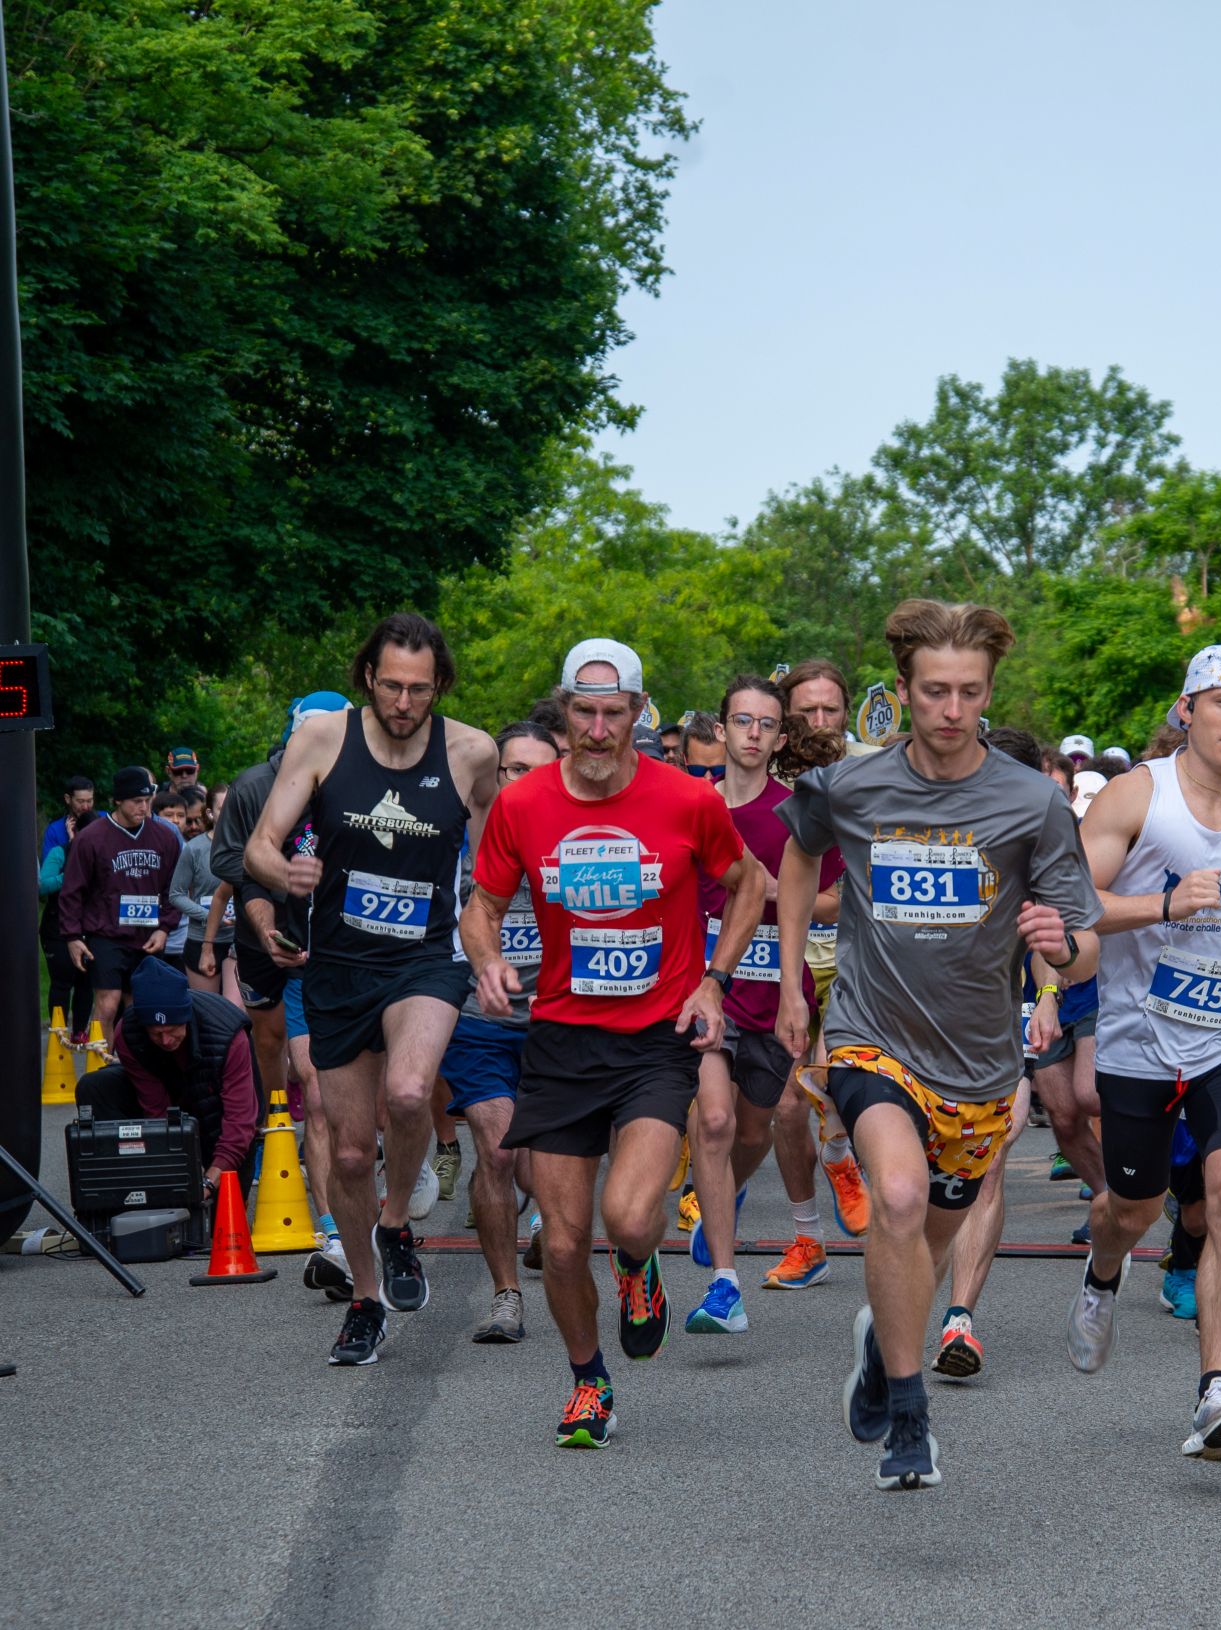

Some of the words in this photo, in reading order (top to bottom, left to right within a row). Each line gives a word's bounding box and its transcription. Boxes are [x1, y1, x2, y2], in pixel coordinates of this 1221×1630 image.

[866, 706, 893, 730] 7:00
[350, 813, 434, 832] PITTSBURGH
[565, 847, 594, 856] FLEET
[112, 852, 161, 873] MINUTEMEN
[546, 875, 558, 885] 20
[573, 866, 625, 885] Liberty
[643, 872, 657, 882] 22
[890, 869, 959, 903] 831
[127, 904, 152, 917] 879
[361, 892, 415, 922] 979
[904, 911, 966, 920] runhigh.com
[366, 920, 415, 936] runhigh.com
[587, 949, 649, 978] 409
[599, 981, 651, 993] runhigh.com
